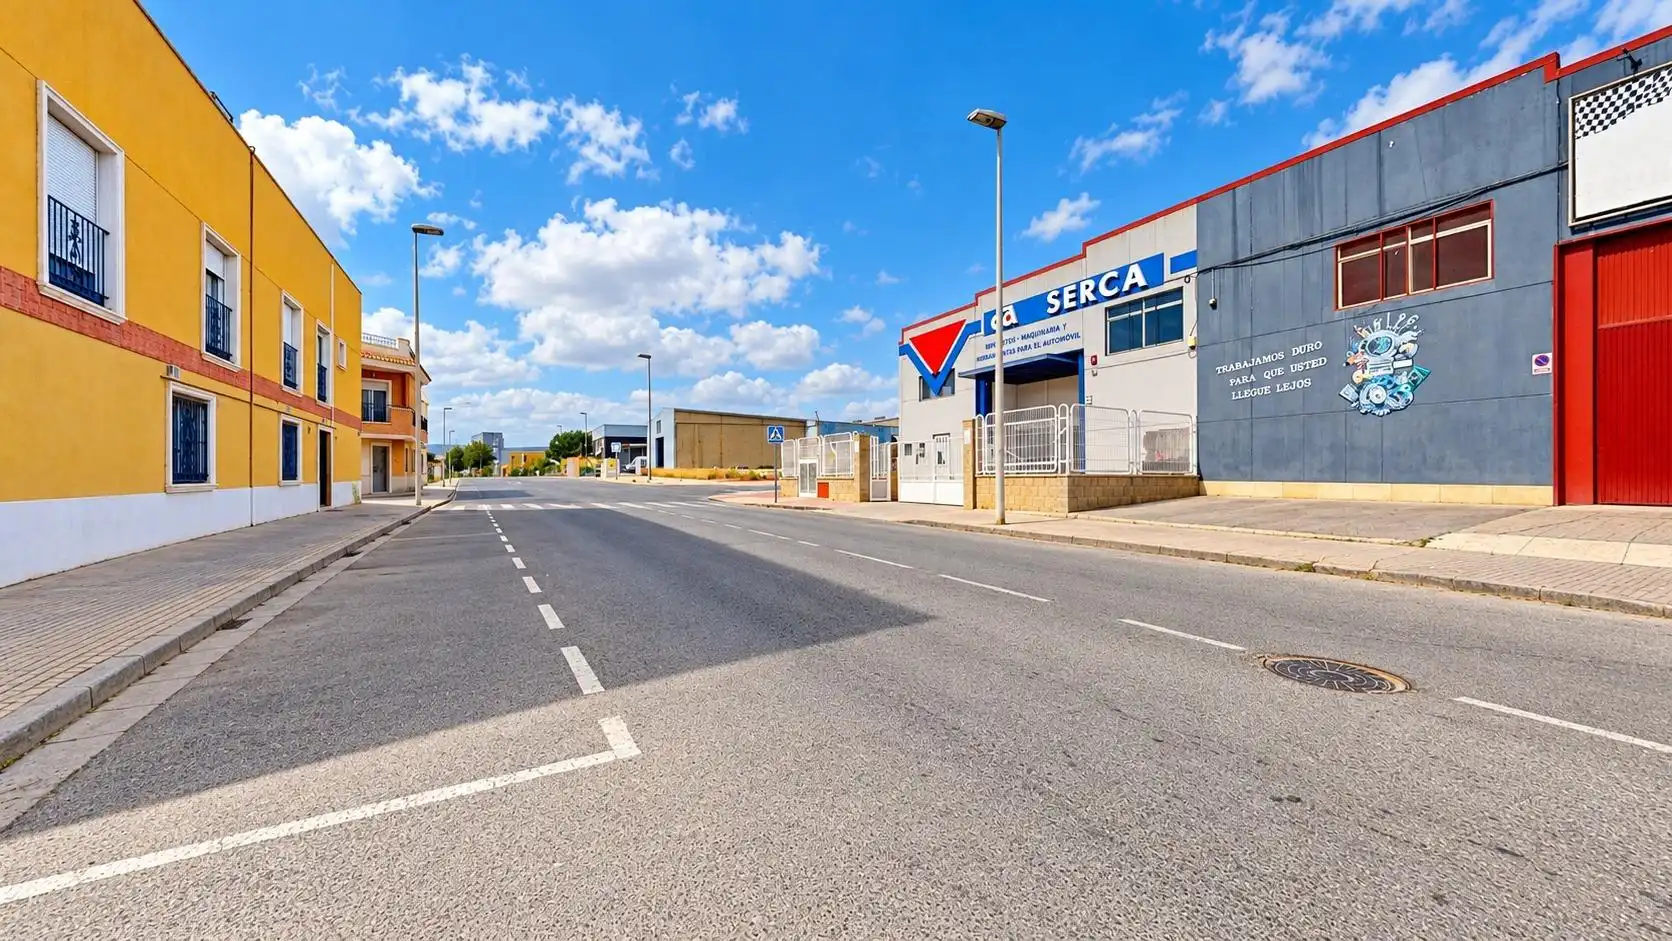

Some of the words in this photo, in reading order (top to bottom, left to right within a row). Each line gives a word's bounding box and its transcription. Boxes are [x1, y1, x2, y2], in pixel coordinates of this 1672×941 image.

[1046, 263, 1148, 314] SERCA
[1042, 331, 1080, 347] AUTOMÓVIL
[1062, 323, 1067, 331] Y
[1215, 351, 1285, 375] TRABAJAMOS
[1291, 340, 1323, 357] DURO
[1229, 374, 1257, 386] PARA
[1263, 367, 1285, 380] QUE
[1289, 356, 1328, 373] USTED
[1231, 385, 1272, 400] LLEGUE
[1276, 378, 1312, 393] LEJOS
